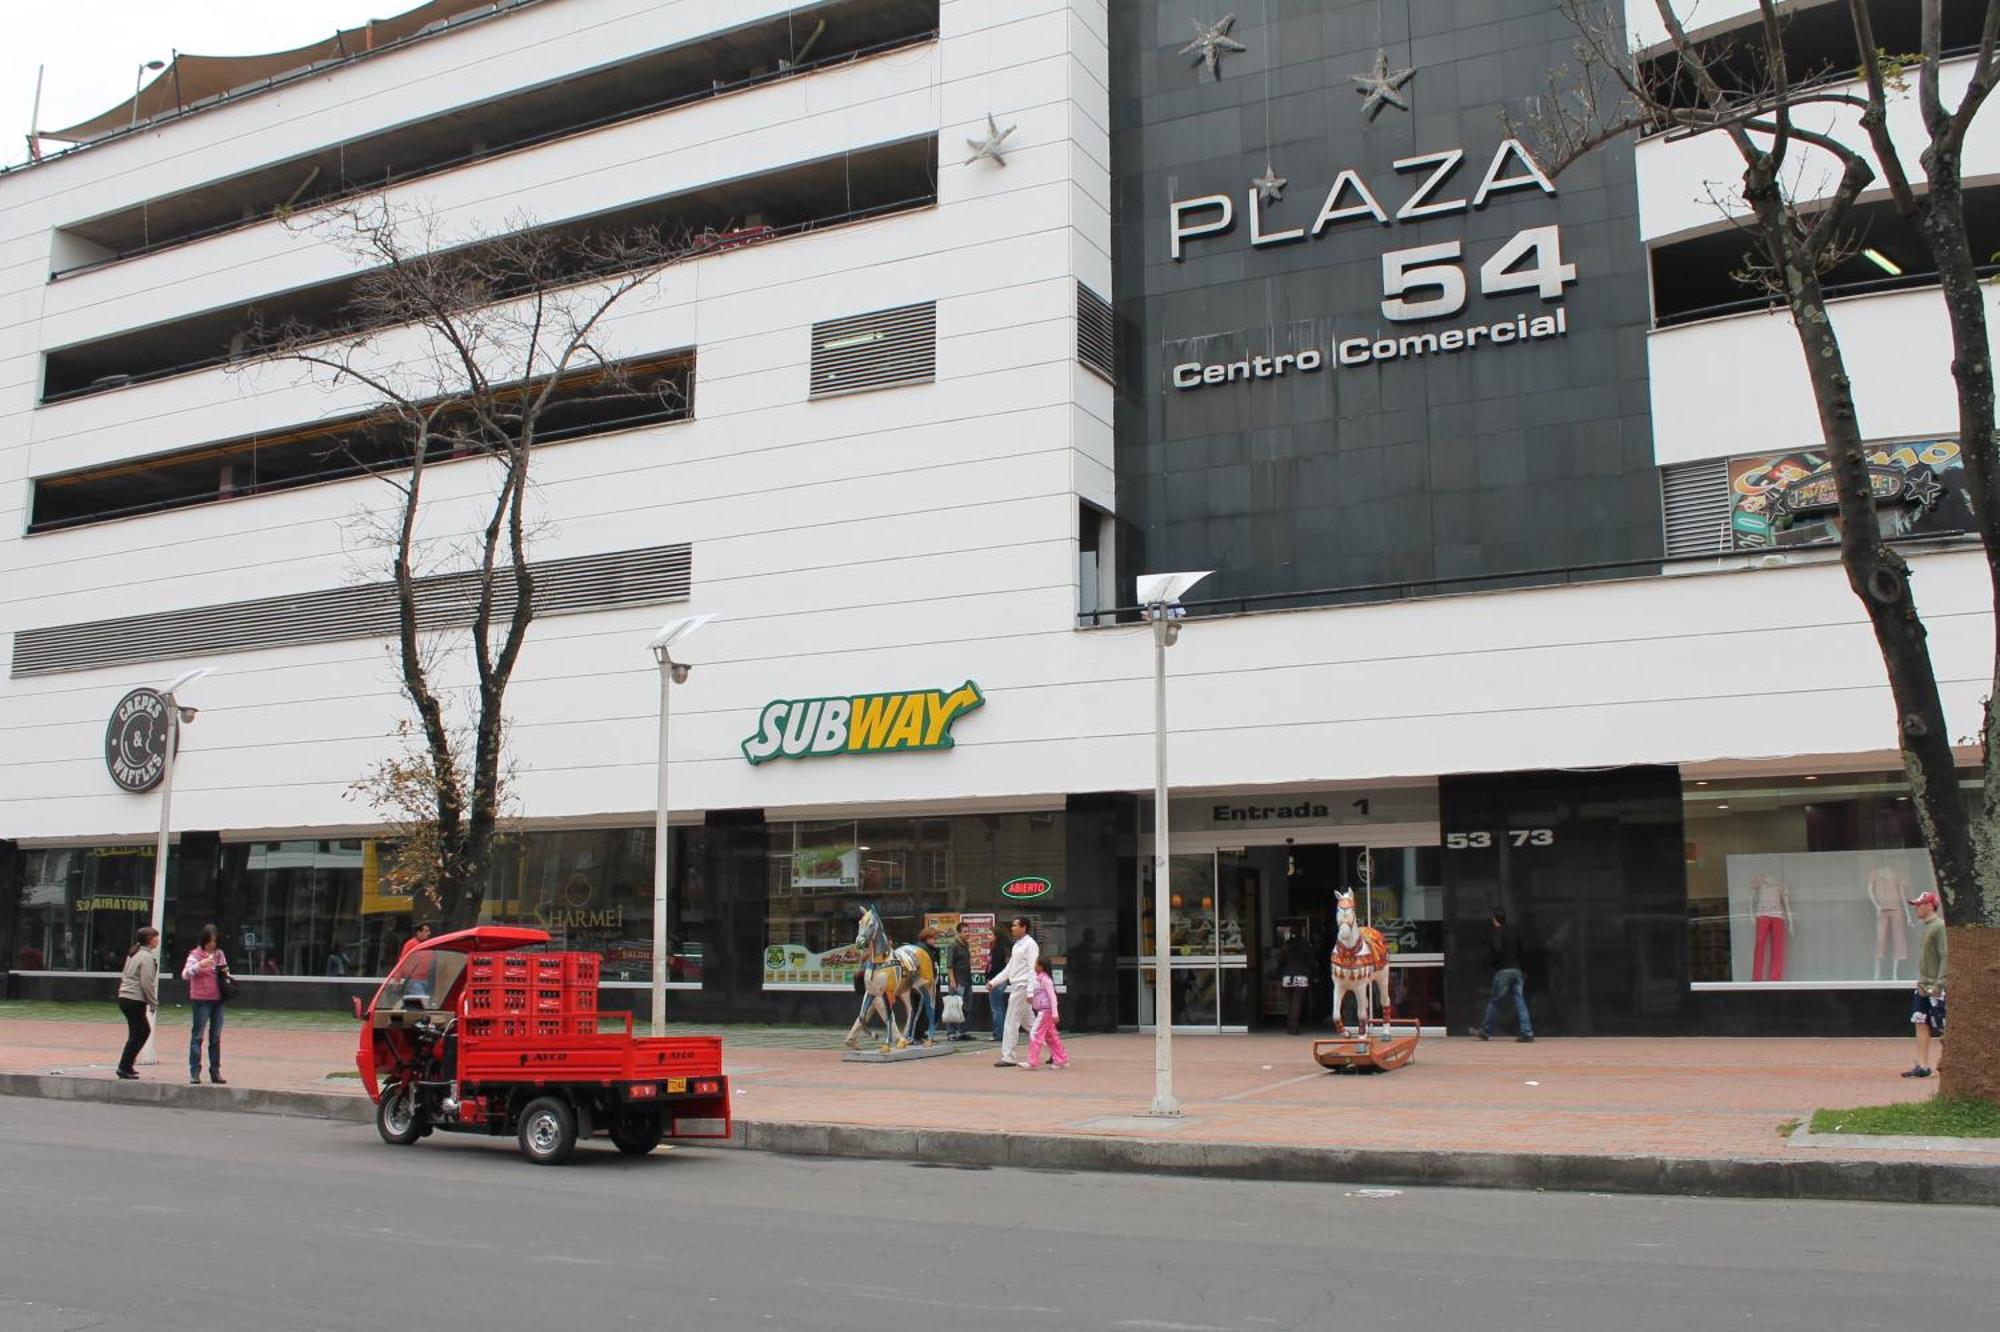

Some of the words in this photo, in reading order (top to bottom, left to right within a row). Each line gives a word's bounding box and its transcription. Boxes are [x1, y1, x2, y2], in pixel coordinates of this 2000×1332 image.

[1170, 138, 1557, 260] PLAZA
[1381, 224, 1577, 322] 54
[1172, 348, 1322, 390] Centro
[1338, 306, 1567, 367] Comercial
[119, 694, 162, 722] CREPES
[744, 684, 979, 760] SUBWAY
[132, 730, 143, 748] &
[112, 752, 163, 785] WAFFLES
[1213, 801, 1329, 821] Entrada
[1352, 798, 1370, 816] 1
[1446, 831, 1492, 849] 53
[1508, 829, 1554, 846] 73
[1008, 882, 1045, 894] ABIERTO
